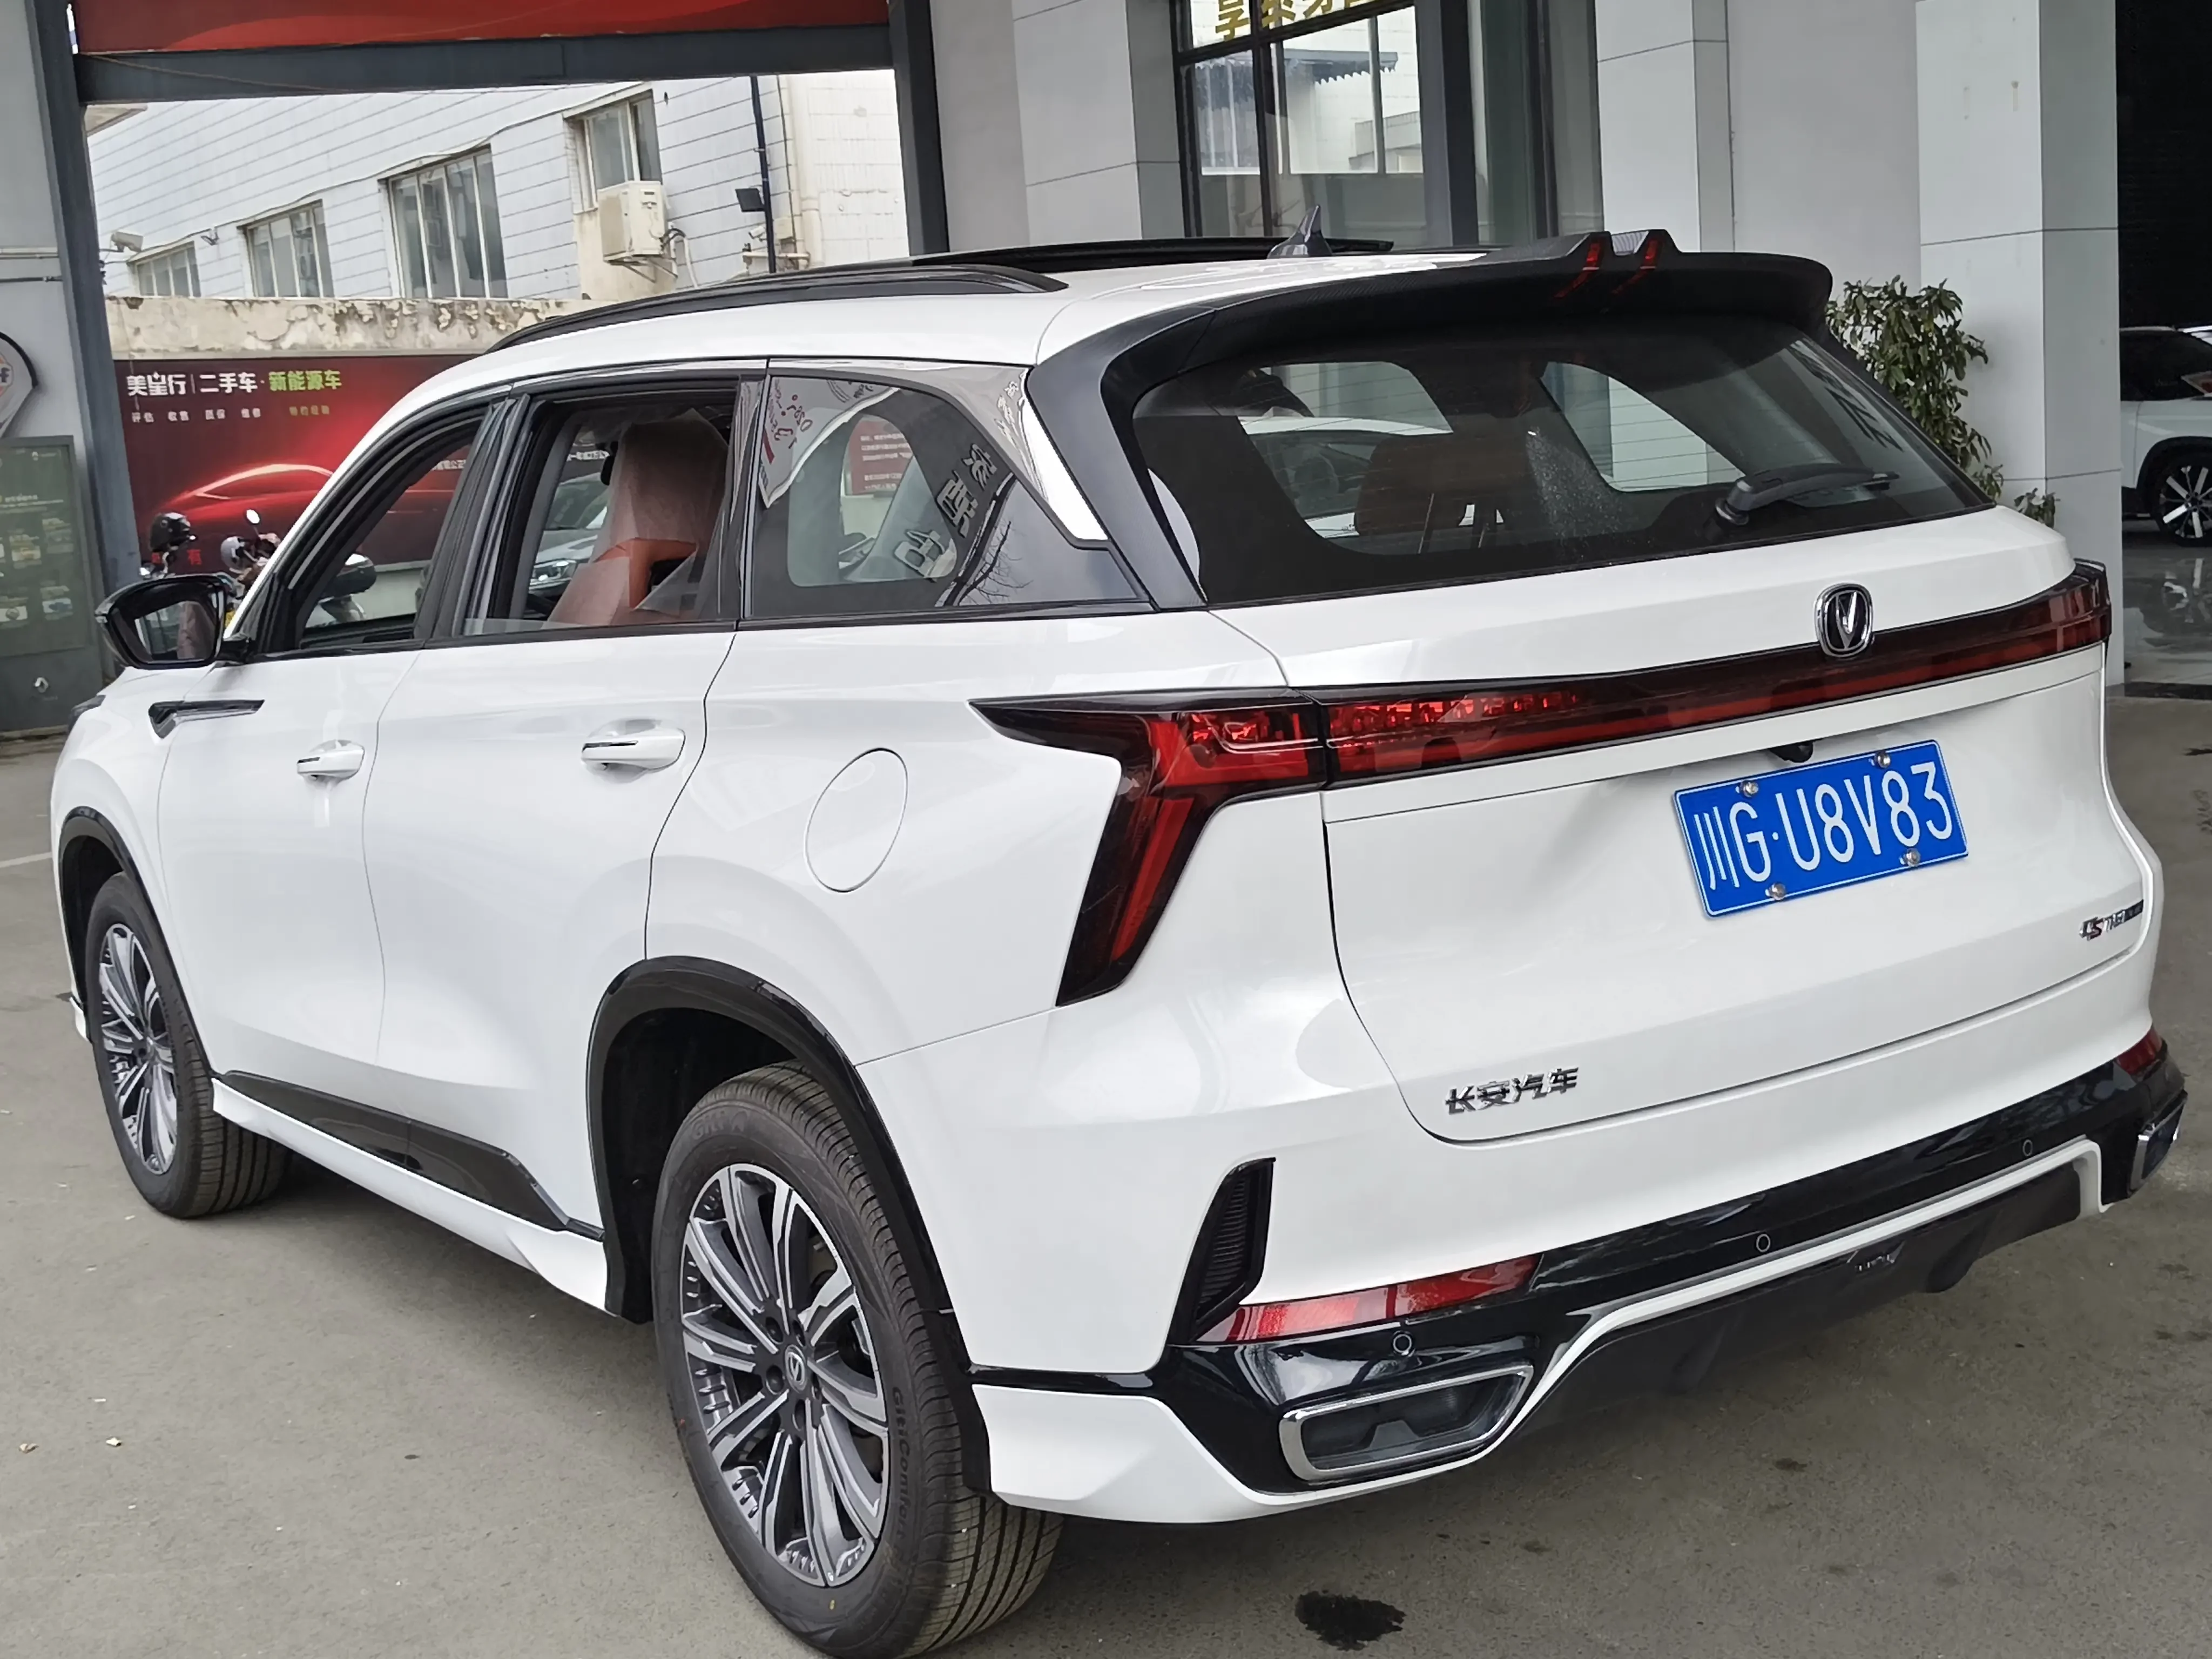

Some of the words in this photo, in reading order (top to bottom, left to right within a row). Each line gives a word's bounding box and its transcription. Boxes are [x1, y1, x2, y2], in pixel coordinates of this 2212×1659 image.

[1694, 760, 1953, 891] 川G·U8V83
[1444, 1067, 1580, 1116] 长安汽车
